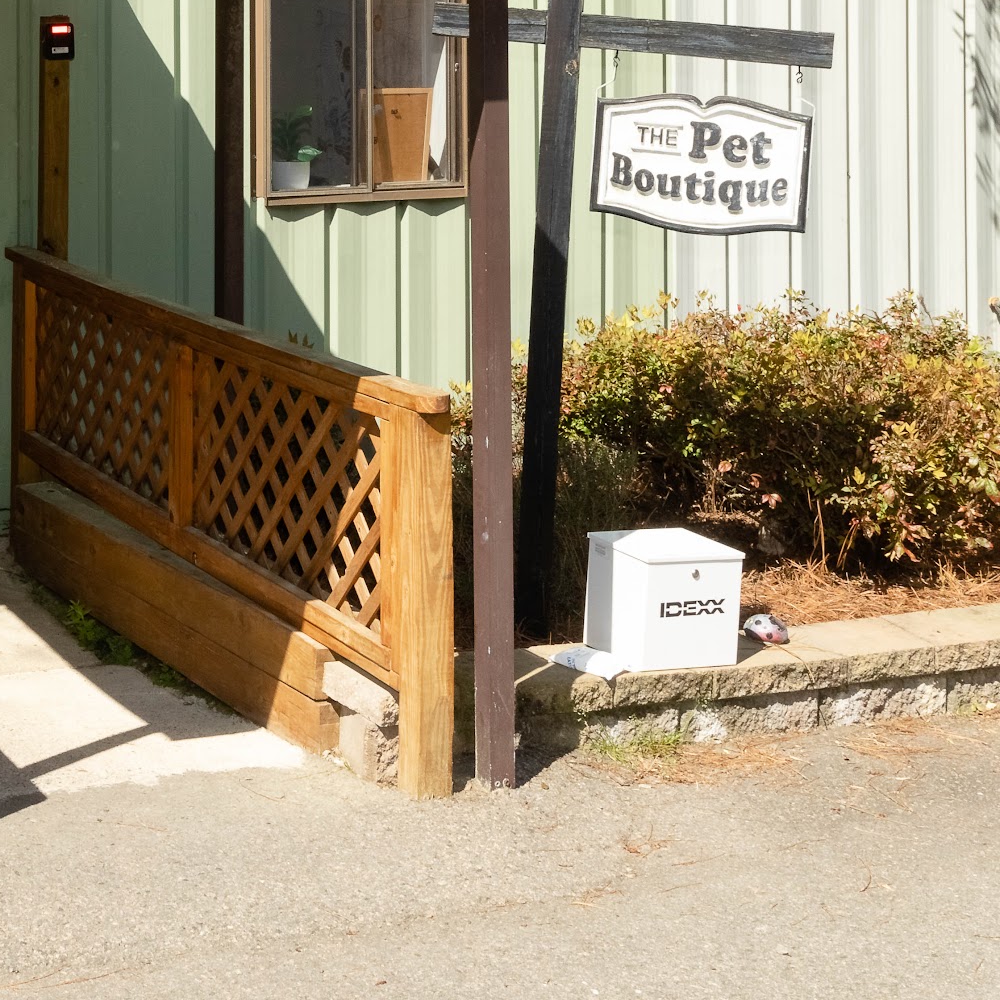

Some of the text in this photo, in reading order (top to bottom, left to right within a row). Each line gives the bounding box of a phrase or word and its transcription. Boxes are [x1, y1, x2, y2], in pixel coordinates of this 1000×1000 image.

[636, 121, 773, 166] THE Pet
[610, 151, 788, 212] Boutique
[659, 598, 726, 618] IDEXX
